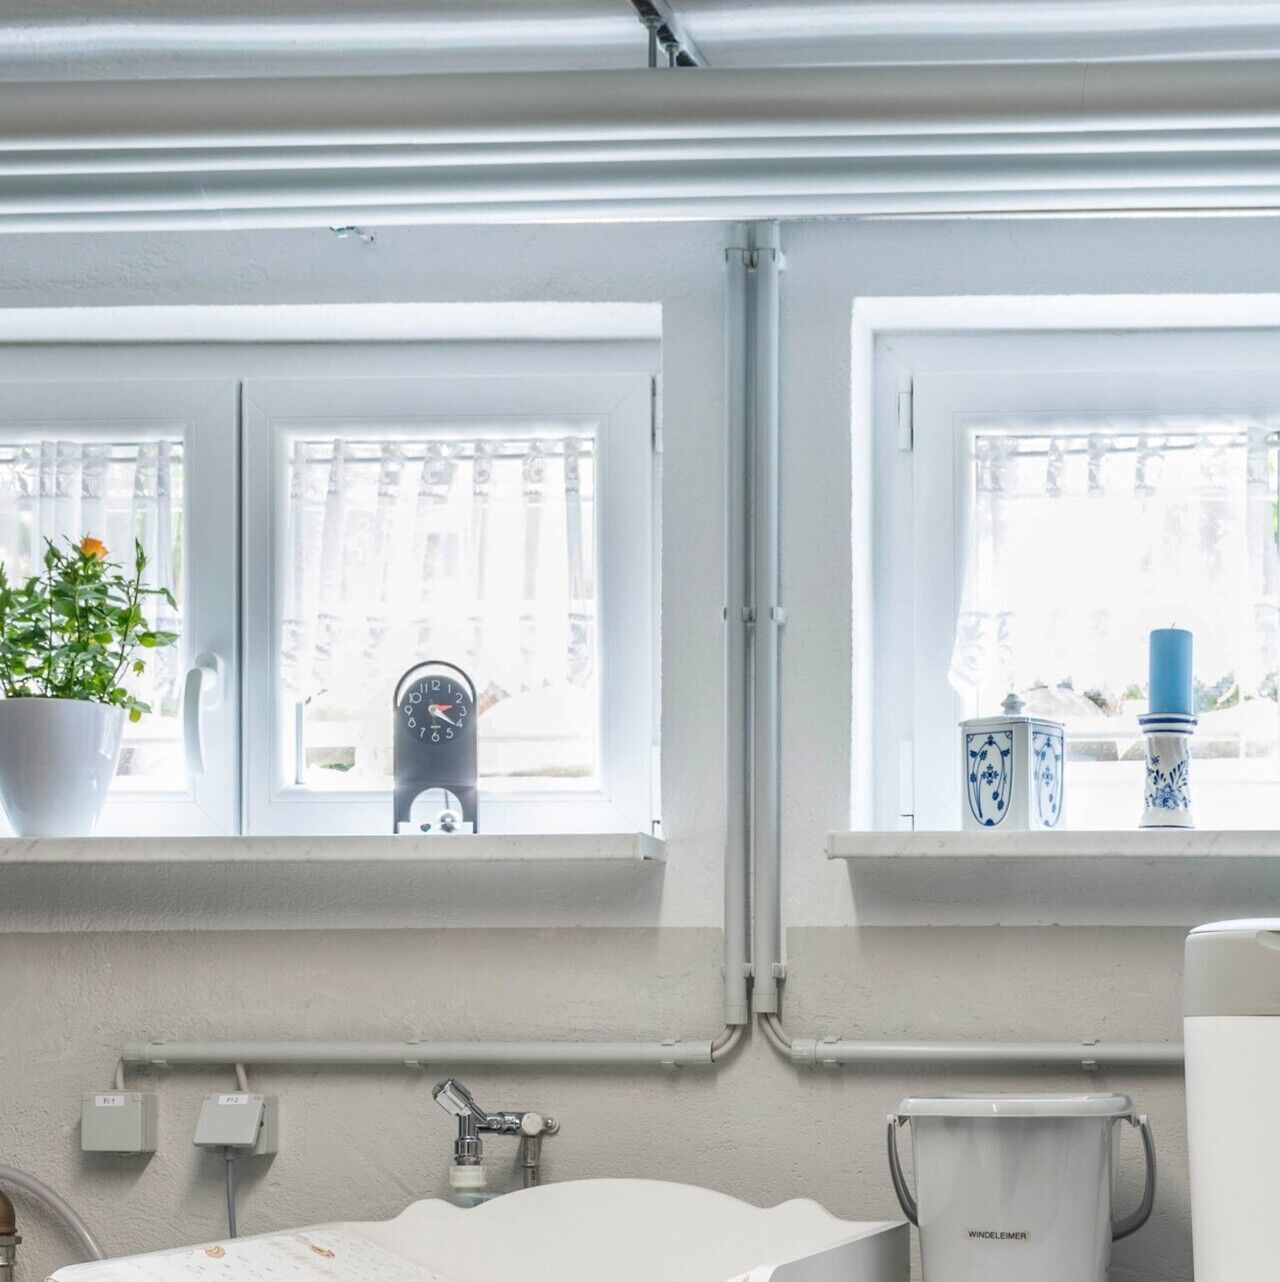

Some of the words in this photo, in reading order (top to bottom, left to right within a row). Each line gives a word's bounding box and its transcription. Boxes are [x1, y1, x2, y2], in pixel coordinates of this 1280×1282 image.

[431, 680, 440, 691] 12
[409, 692, 422, 703] 10
[456, 693, 463, 704] 2
[404, 705, 413, 716] 9
[460, 706, 467, 717] 3
[408, 717, 416, 728] 8
[456, 719, 463, 728] 4
[420, 727, 426, 738] 7
[431, 731, 440, 742] 6
[446, 728, 454, 739] 5
[967, 1230, 1027, 1240] WINDELEIMER
